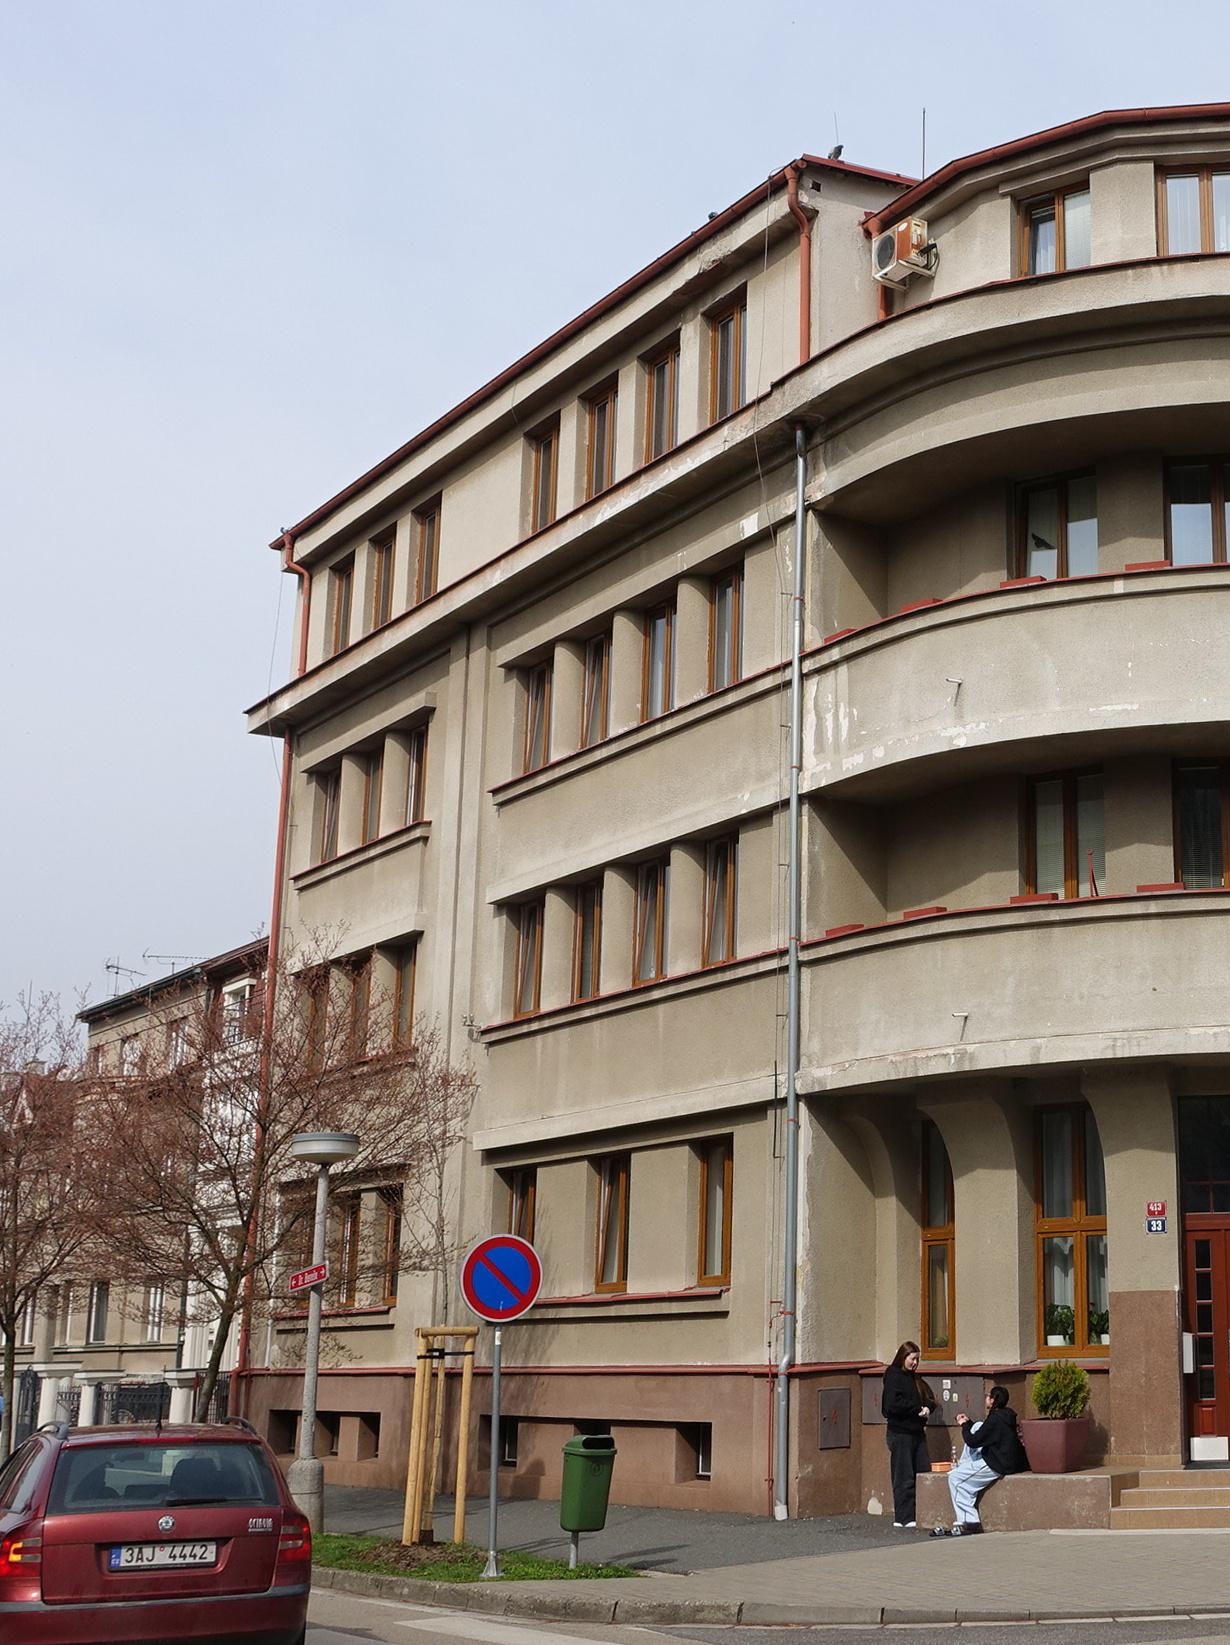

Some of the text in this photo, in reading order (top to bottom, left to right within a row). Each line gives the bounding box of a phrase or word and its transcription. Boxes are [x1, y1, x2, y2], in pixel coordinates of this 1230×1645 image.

[1149, 1203, 1162, 1211] 413
[1151, 1220, 1162, 1231] 33
[124, 1543, 208, 1564] 3AJ 4442
